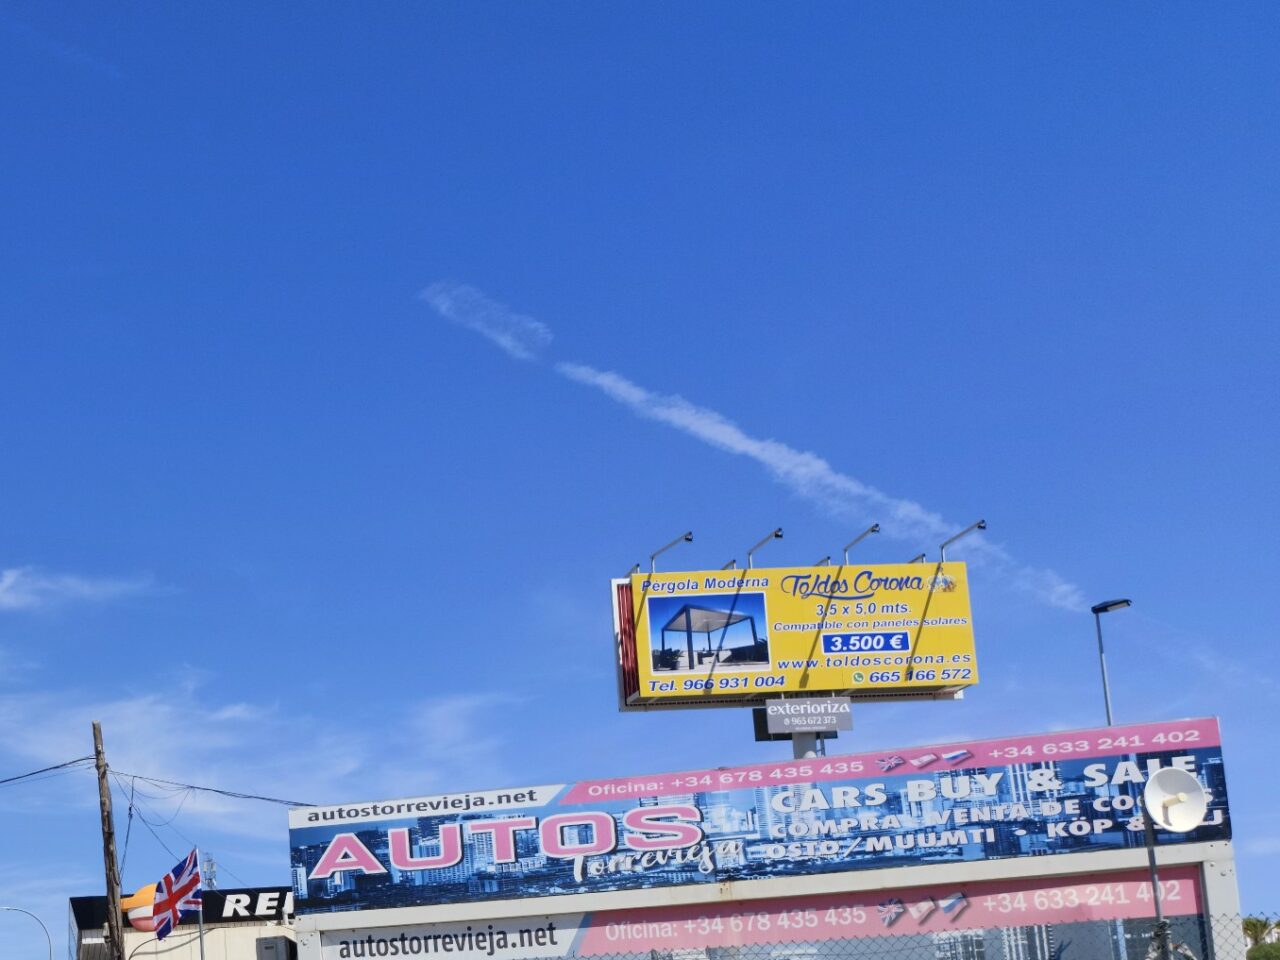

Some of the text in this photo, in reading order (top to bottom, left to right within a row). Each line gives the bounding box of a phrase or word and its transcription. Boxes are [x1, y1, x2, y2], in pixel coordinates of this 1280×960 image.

[704, 577, 769, 590] Moderna
[781, 571, 924, 599] Toldos Corona
[842, 606, 850, 615] x
[881, 602, 912, 614] mts.
[773, 616, 968, 632] Compatible con paneles solares
[830, 634, 904, 651] 3.500 €
[777, 654, 971, 670] www.toldoscorona.es
[869, 668, 972, 683] 665 166 572
[648, 675, 785, 692] Tel. 966 931 004
[767, 700, 850, 716] exterioriza
[988, 729, 1201, 759] +34 633 241 402
[587, 760, 865, 798] Oficina: +34 678 435 435
[770, 783, 888, 814] CARS
[906, 772, 1004, 803] BUY
[1028, 768, 1064, 792] &
[307, 788, 538, 823] autostorrevieja.net
[770, 814, 902, 839] COMPRA
[929, 803, 1030, 826] VENTA
[1041, 799, 1081, 817] DE
[1046, 816, 1113, 839] KÖP
[307, 804, 705, 881] AUTOS
[572, 839, 744, 884] Torrevieja
[983, 891, 1028, 914] +34
[1034, 888, 1080, 911] 633
[1085, 884, 1131, 908] 241
[605, 903, 867, 943] Oficina: +34 678 435 435
[339, 921, 559, 959] autostorrevieja.net
